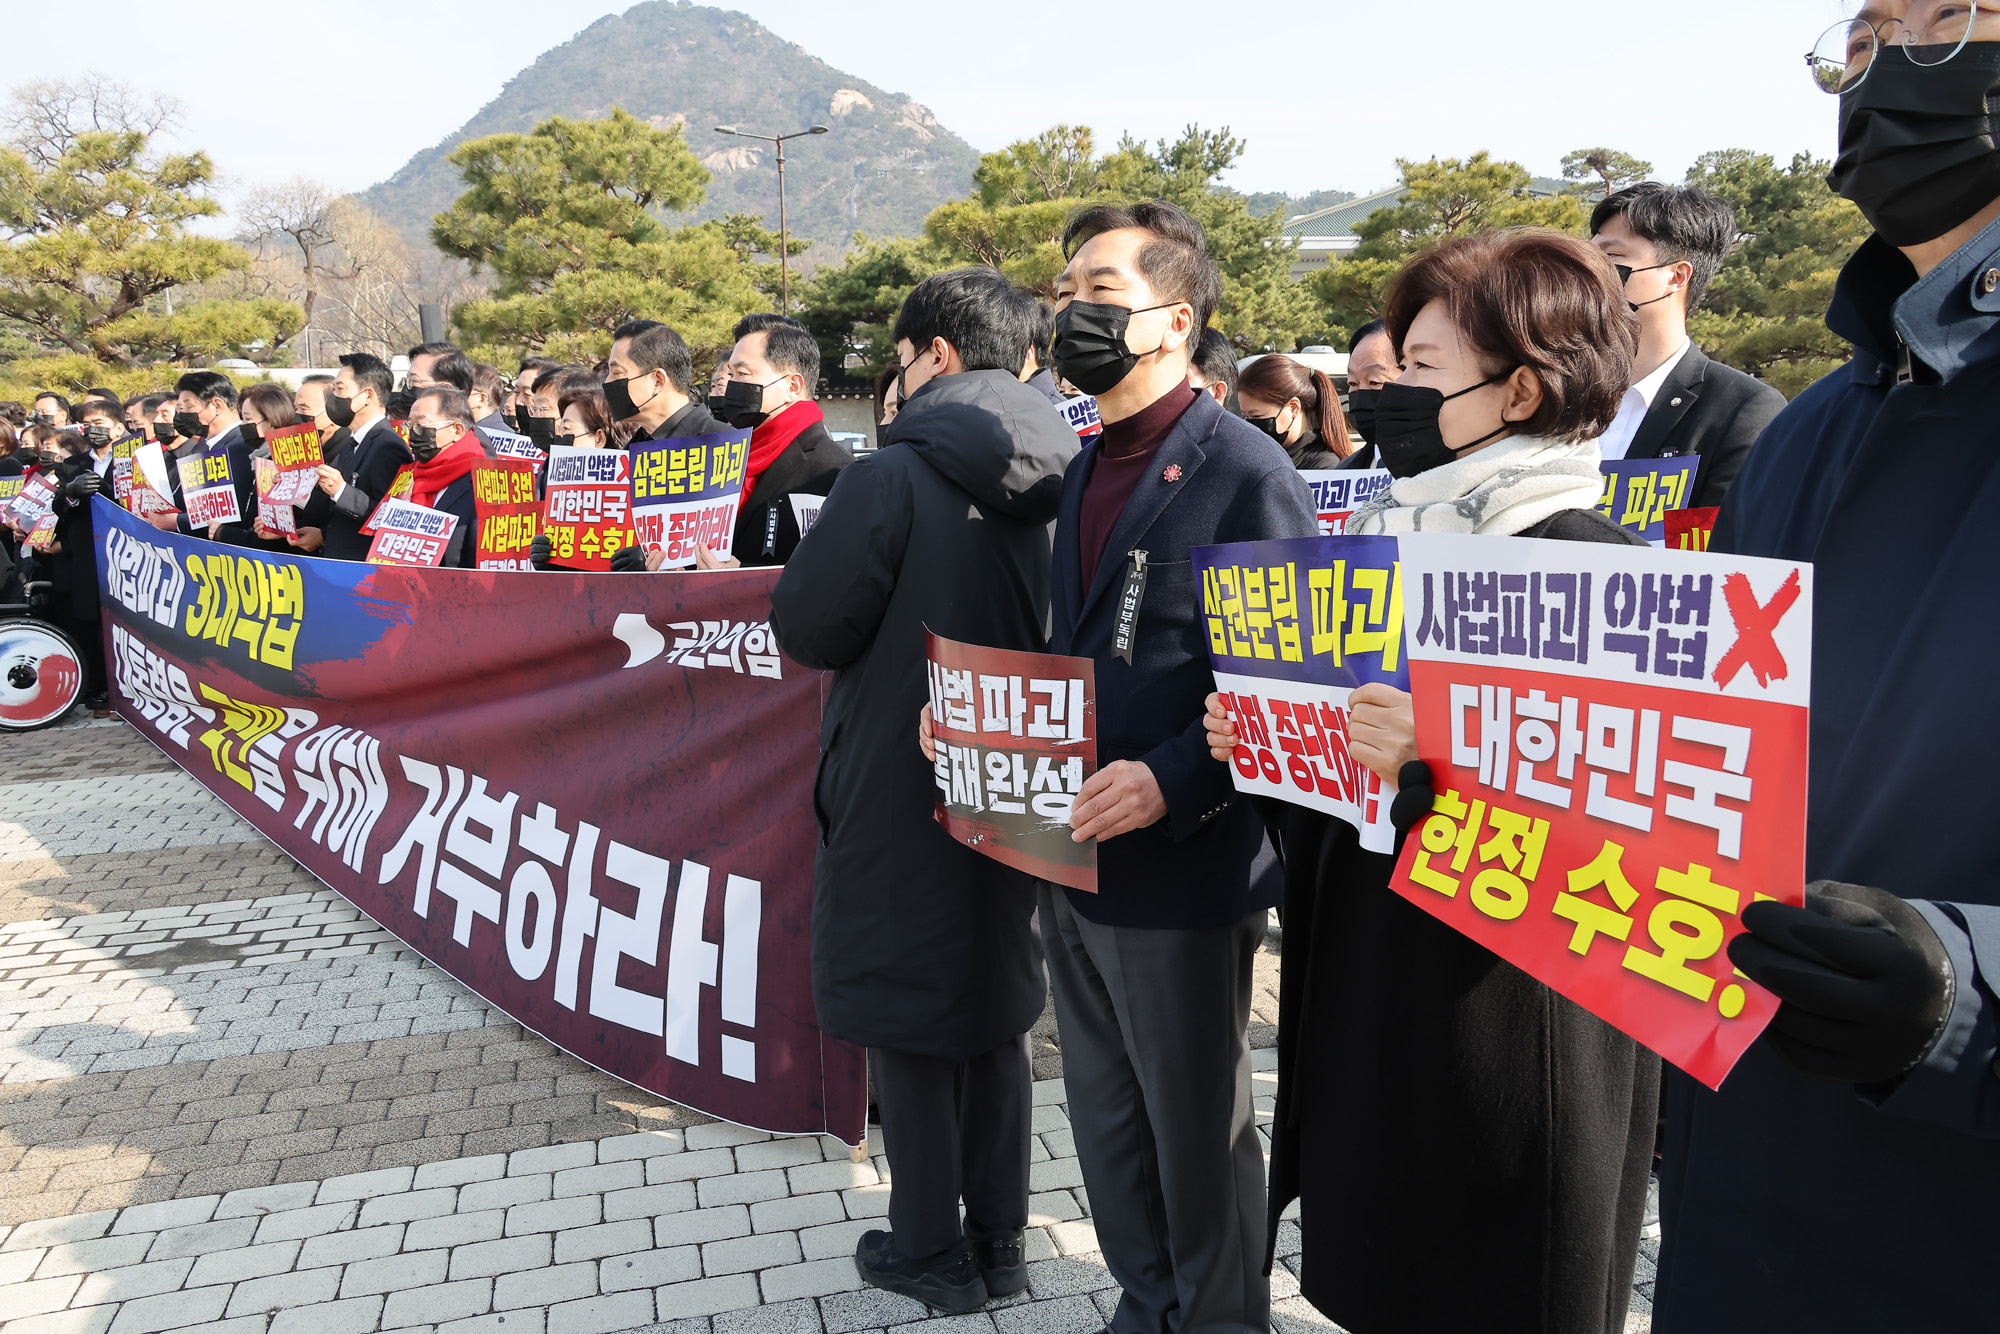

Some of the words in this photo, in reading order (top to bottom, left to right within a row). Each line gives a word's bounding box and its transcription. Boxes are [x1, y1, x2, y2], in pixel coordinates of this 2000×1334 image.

[205, 453, 230, 482] 파괴
[272, 432, 307, 467] 사법파괴
[304, 430, 321, 461] 3법
[550, 455, 585, 482] 사법파괴
[587, 455, 617, 482] 악법
[633, 445, 707, 498] 삼권분립
[709, 437, 748, 489] 파괴
[476, 467, 511, 505] 사법파괴
[511, 471, 534, 504] 3법
[550, 489, 628, 524] 대한민국
[1620, 468, 1690, 531] 파괴
[376, 532, 441, 566] 대한민국
[383, 508, 423, 530] 사법파괴
[420, 513, 444, 535] 악법
[480, 512, 538, 553] 사법파괴
[545, 525, 576, 559] 헌정
[667, 504, 734, 560] 중단하라!
[105, 526, 186, 629] 사법파괴
[185, 553, 305, 671] 3대악법
[1202, 561, 1304, 663] 삼권분립
[1308, 559, 1404, 673] 파괴
[1415, 570, 1592, 664] 사법파괴
[1603, 571, 1713, 680] 악법
[664, 619, 783, 680] 국민의힘
[1217, 690, 1283, 785] 당장
[1267, 697, 1382, 825] 중단하!
[1449, 681, 1753, 861] 대한민국
[112, 623, 216, 750] 대통령은
[198, 681, 319, 813] 국민을
[292, 724, 389, 874] 위해
[378, 754, 762, 1084] 거부하라!
[1408, 788, 1551, 921] 헌정
